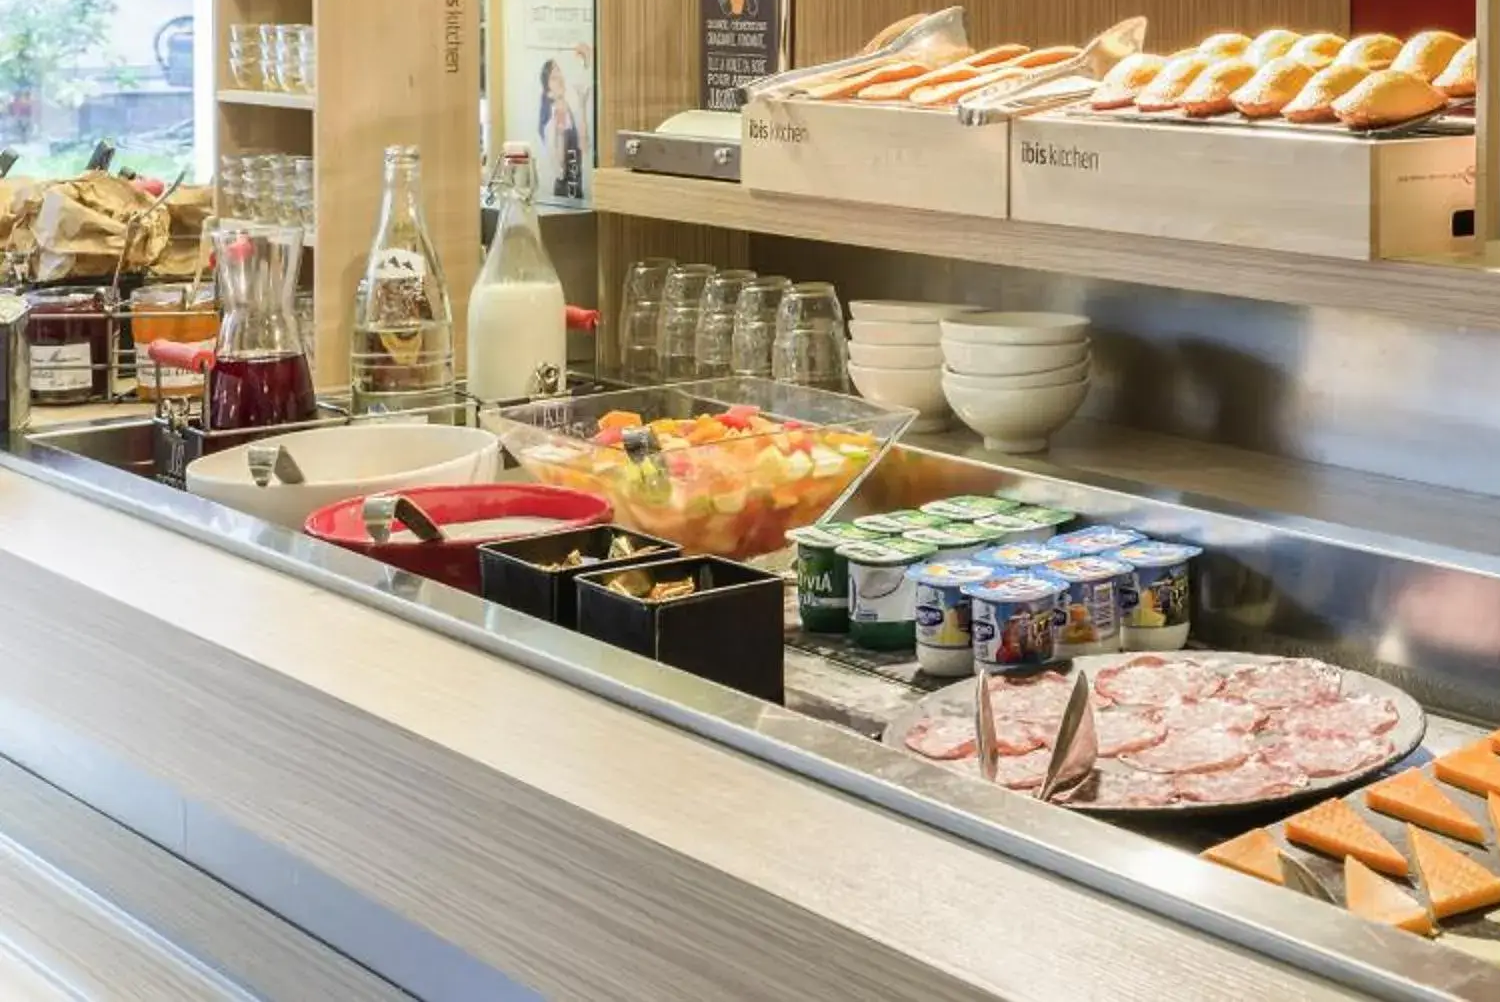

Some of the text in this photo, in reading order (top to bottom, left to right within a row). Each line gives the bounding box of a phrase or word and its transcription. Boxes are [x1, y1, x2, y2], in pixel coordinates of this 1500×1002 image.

[748, 119, 768, 140] ibis
[1020, 142, 1100, 172] ibis kitchen
